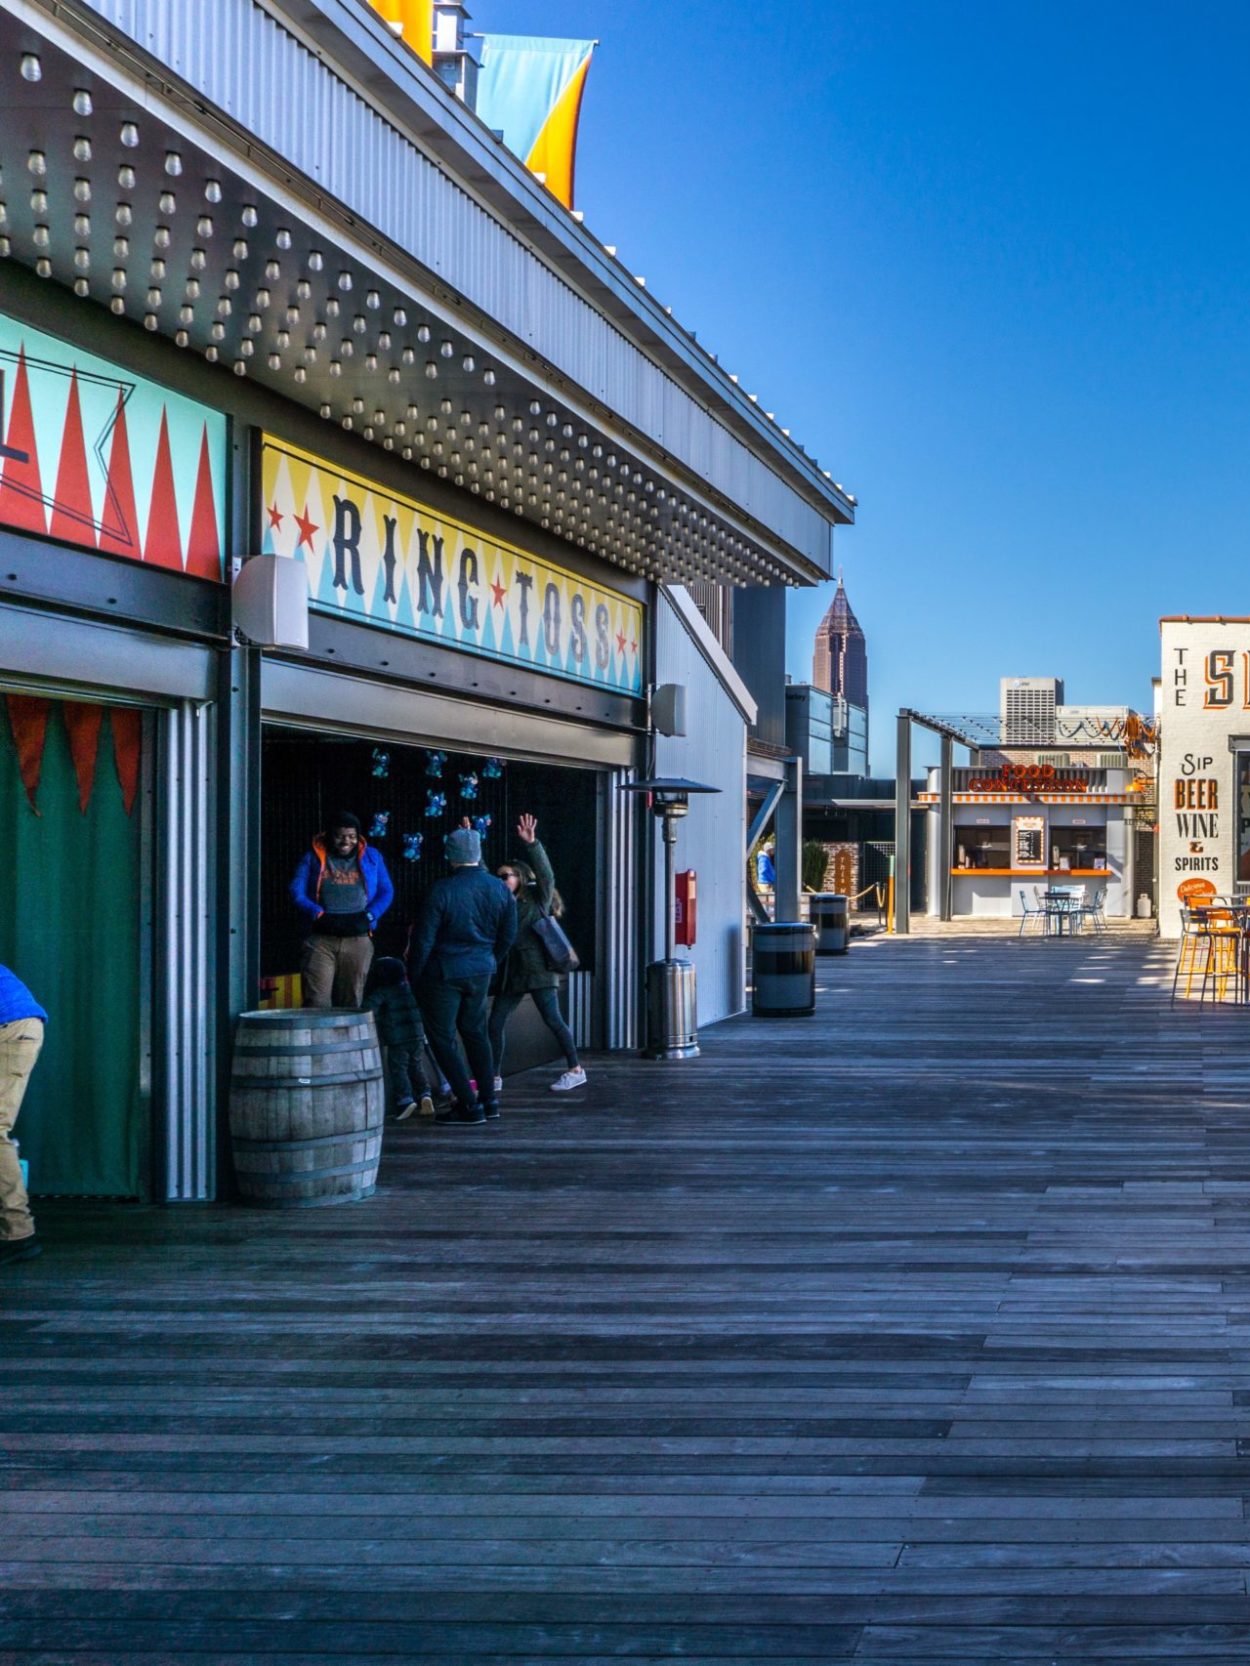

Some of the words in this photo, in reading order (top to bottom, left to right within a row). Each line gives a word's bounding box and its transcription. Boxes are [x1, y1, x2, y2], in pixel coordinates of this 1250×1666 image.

[332, 494, 480, 630] RING
[515, 570, 609, 671] TOSS
[1173, 648, 1189, 707] THE
[1001, 764, 1054, 778] FOOD
[968, 777, 1088, 792] CONCESSION
[1174, 778, 1218, 810] BEER
[1176, 813, 1219, 838] WINE
[1175, 857, 1219, 871] SPIRITS
